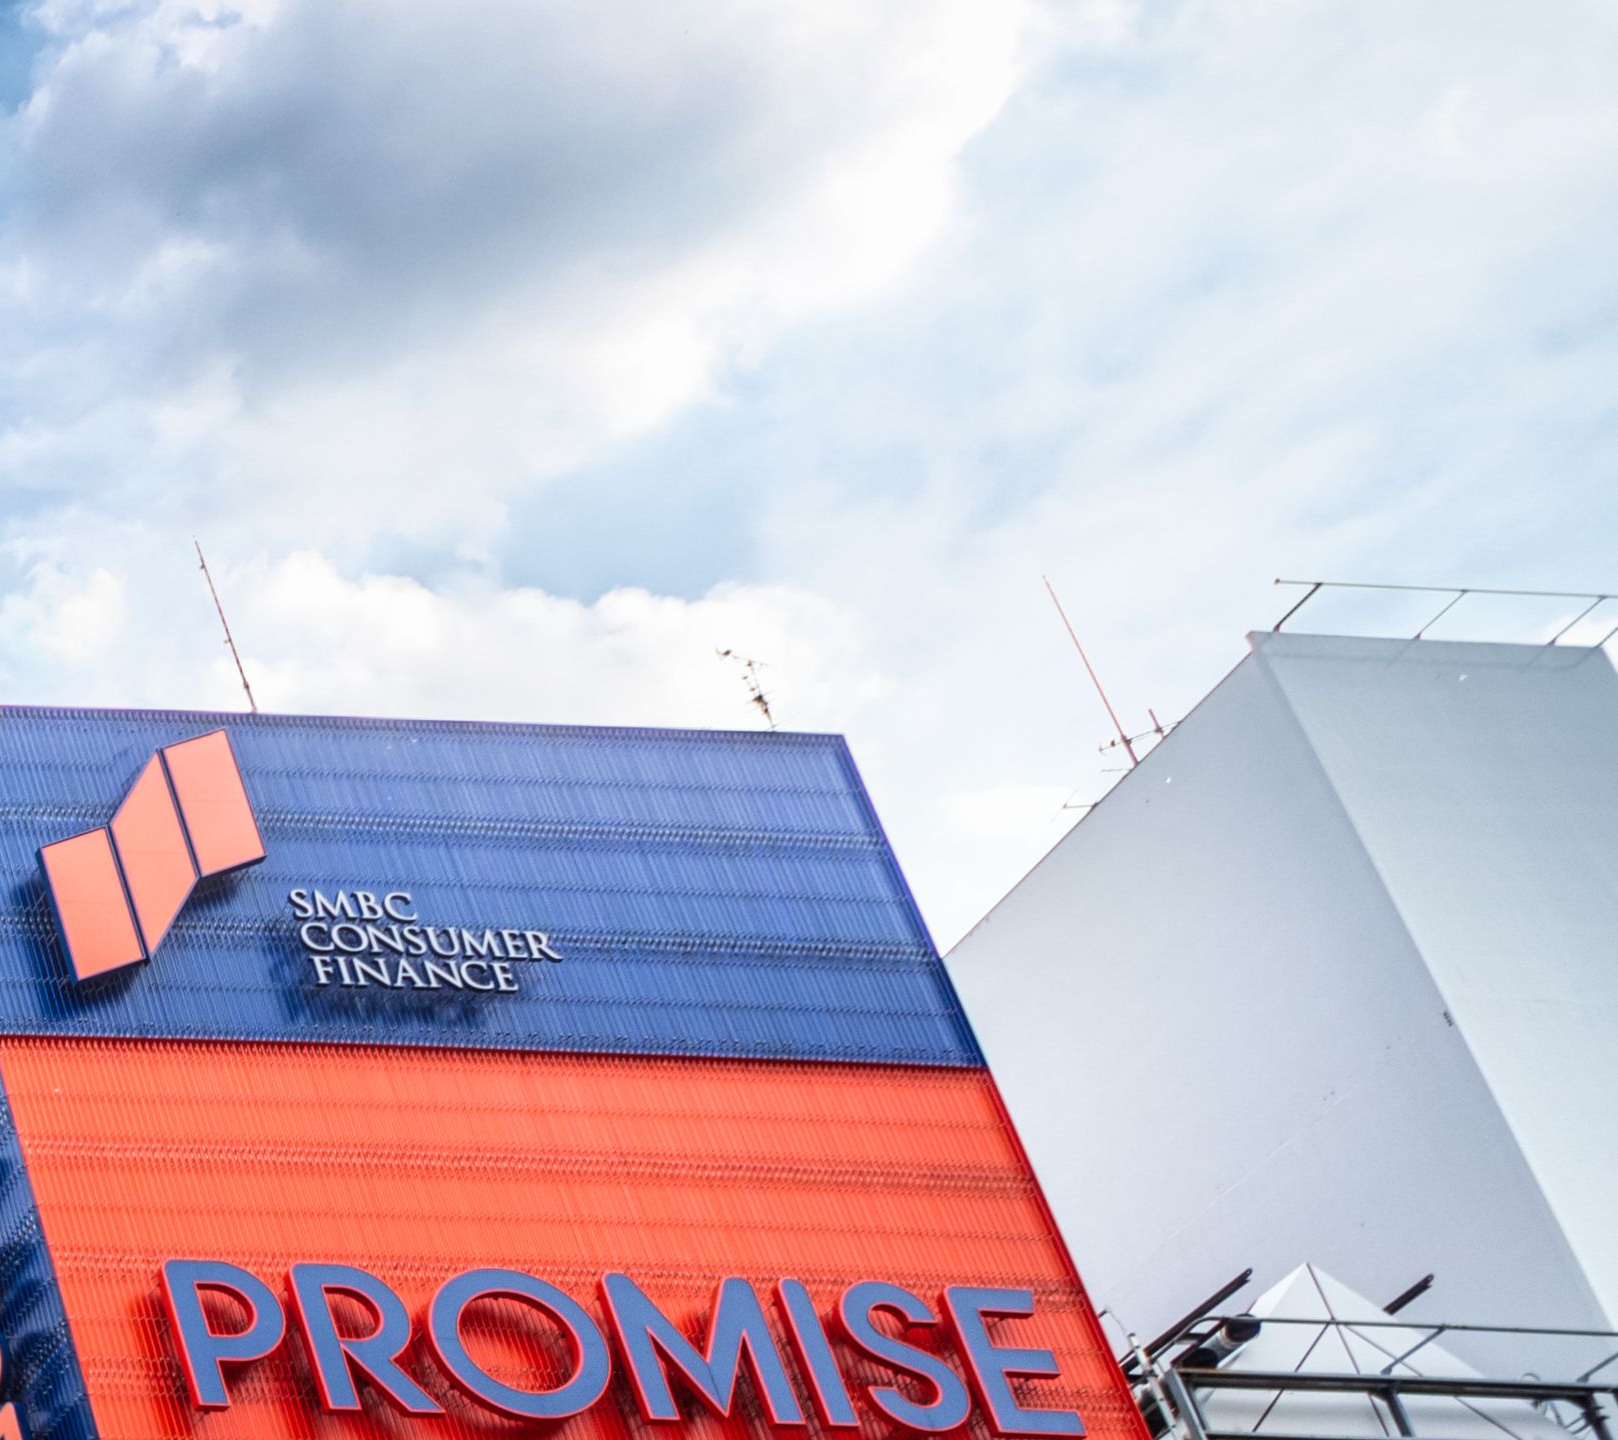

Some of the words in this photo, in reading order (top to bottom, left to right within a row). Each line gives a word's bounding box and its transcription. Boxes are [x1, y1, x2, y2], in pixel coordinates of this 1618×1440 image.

[291, 888, 417, 925] SMBC
[300, 922, 563, 963] CONSUMER
[315, 955, 521, 992] FINANCE
[160, 1257, 1087, 1440] PROMISE
